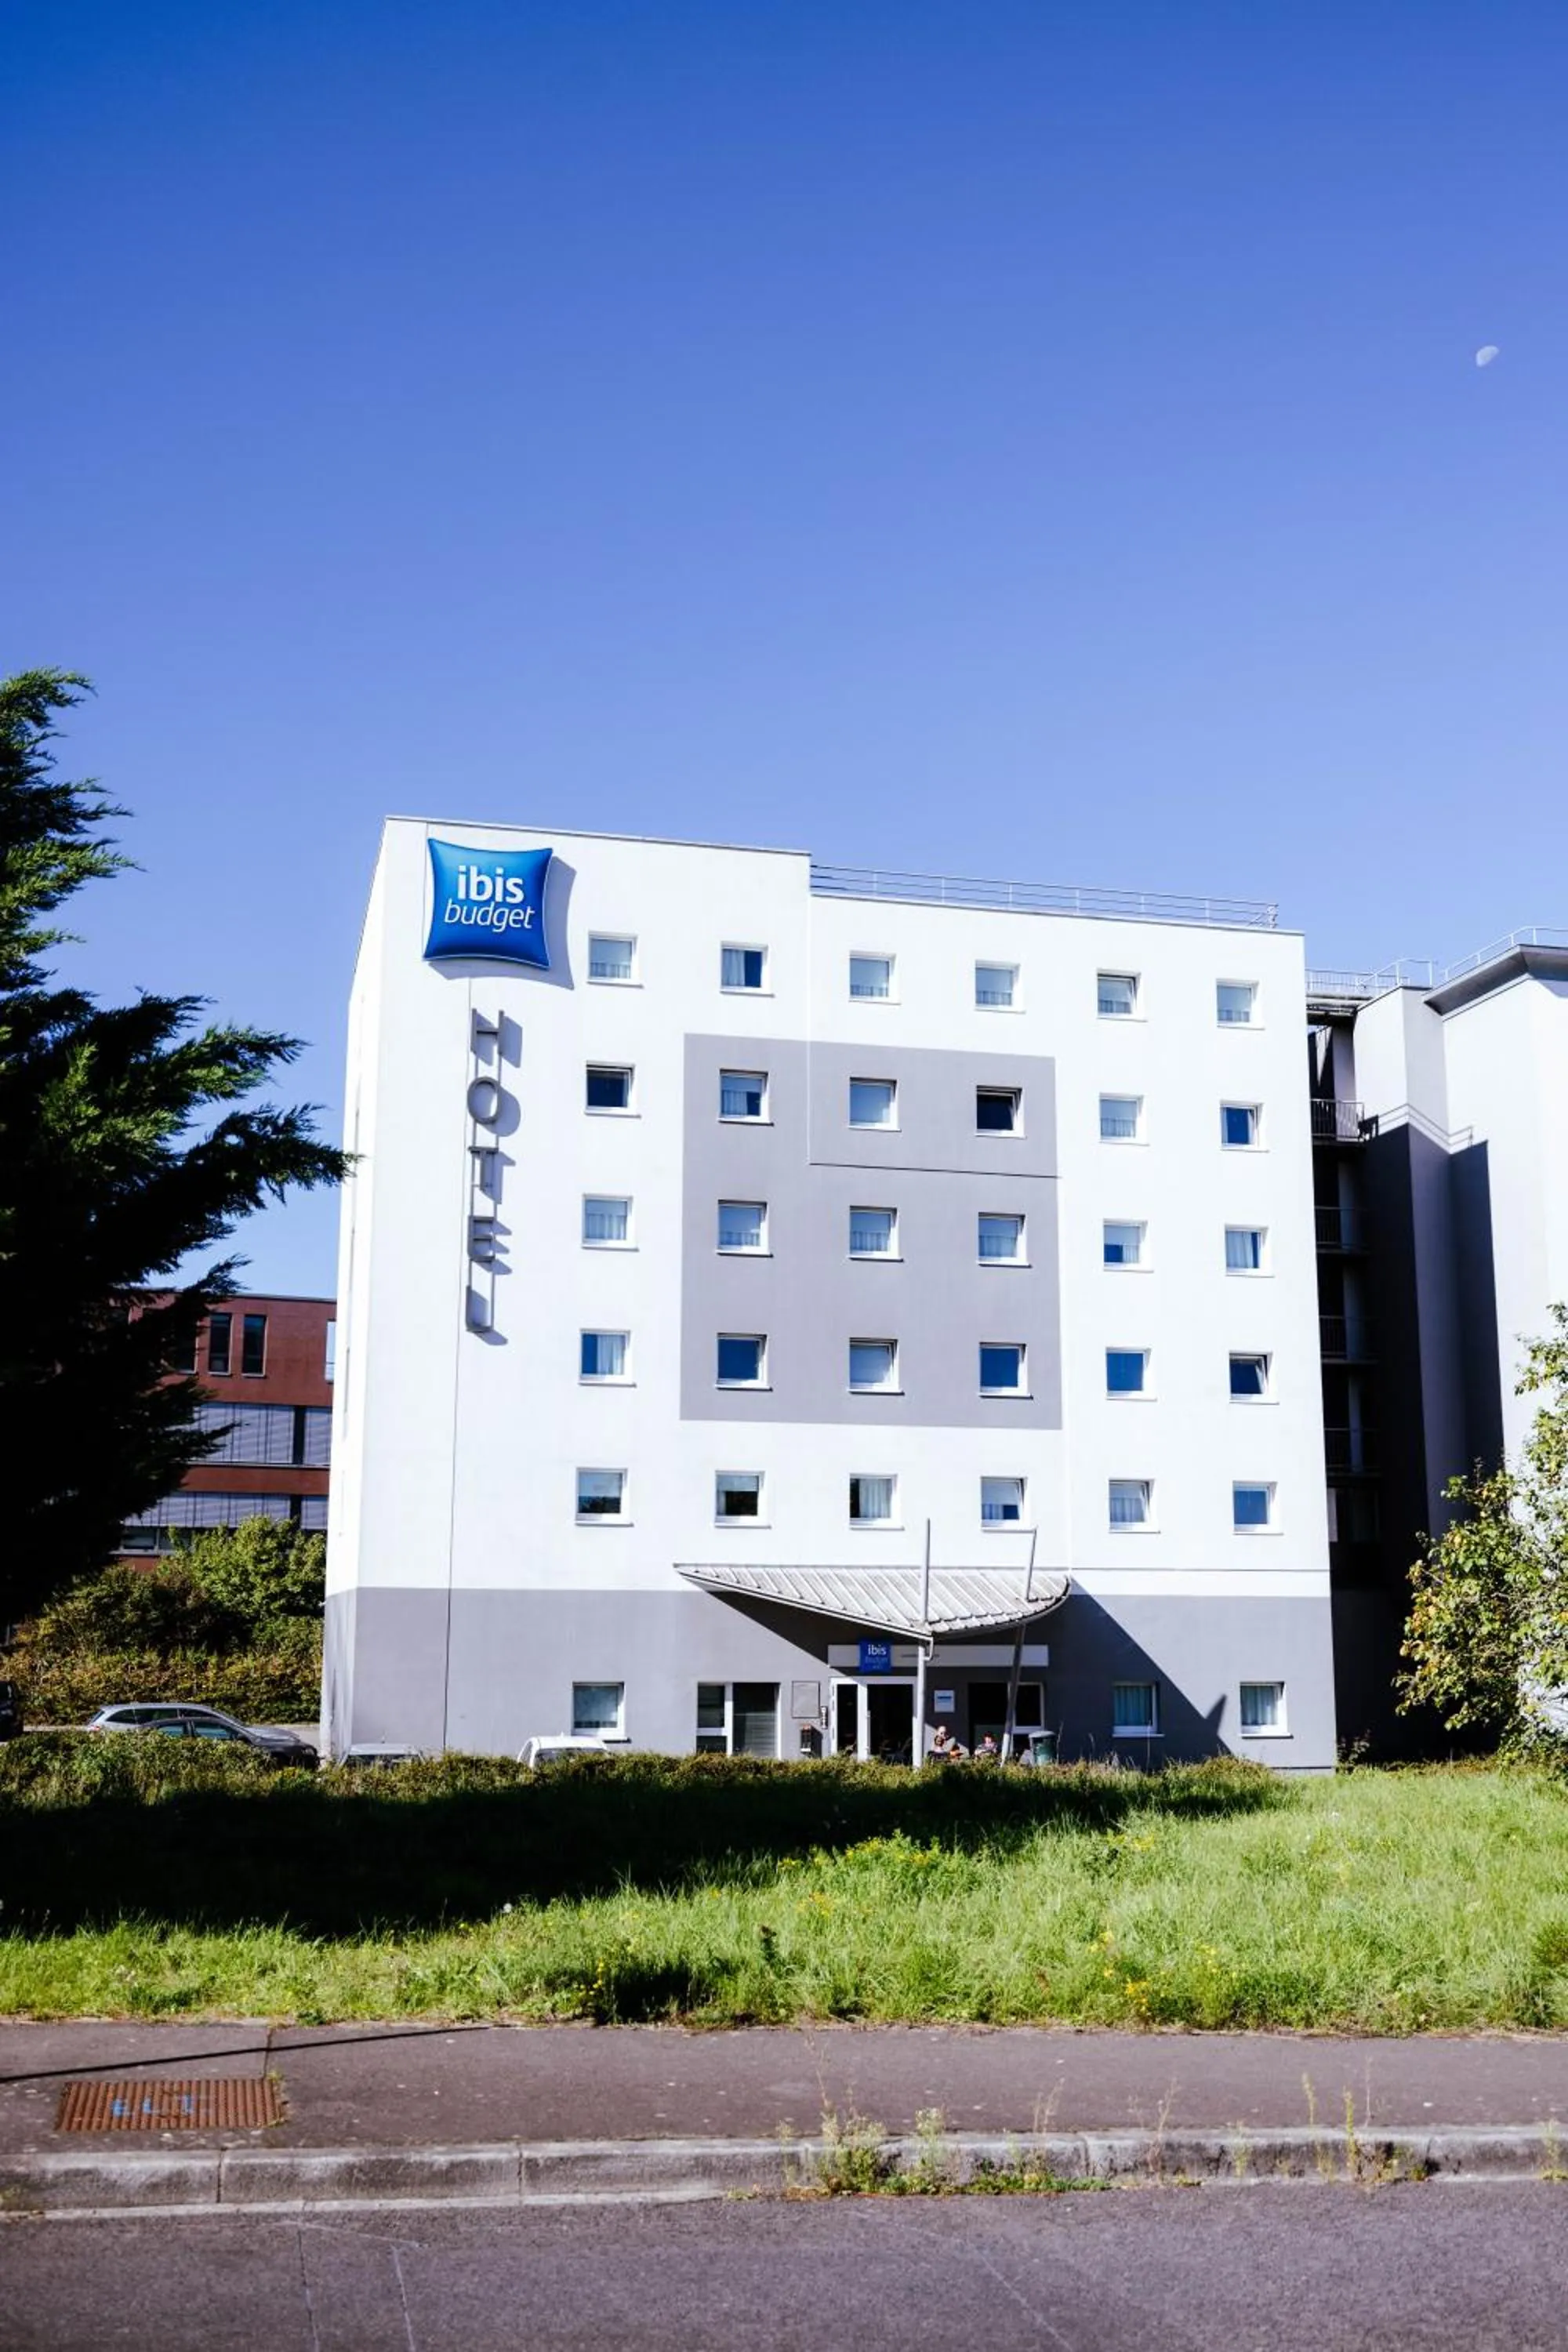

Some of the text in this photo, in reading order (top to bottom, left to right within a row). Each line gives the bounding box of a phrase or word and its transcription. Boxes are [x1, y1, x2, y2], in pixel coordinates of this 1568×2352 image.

[458, 865, 524, 903] ibis
[444, 898, 535, 933] budget
[466, 1008, 505, 1332] HOTEL
[867, 1643, 887, 1655] ibis
